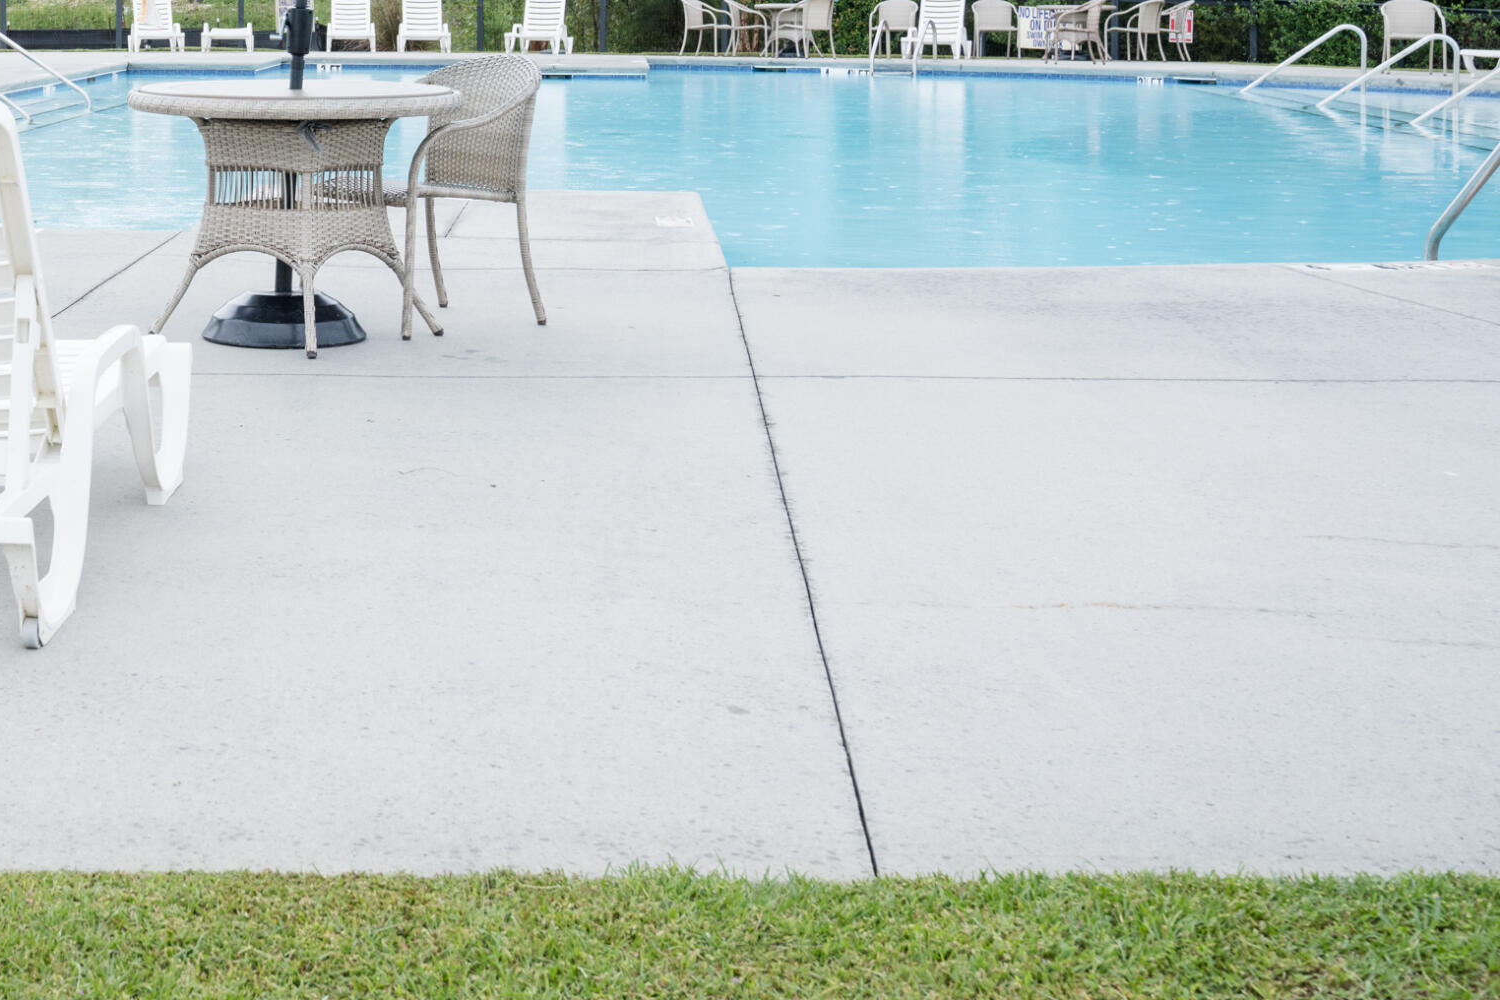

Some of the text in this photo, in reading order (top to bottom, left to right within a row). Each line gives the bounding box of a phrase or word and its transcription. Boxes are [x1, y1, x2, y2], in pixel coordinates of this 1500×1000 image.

[1019, 7, 1030, 19] NO
[1030, 19, 1041, 31] ON
[1027, 31, 1043, 39] SWIM
